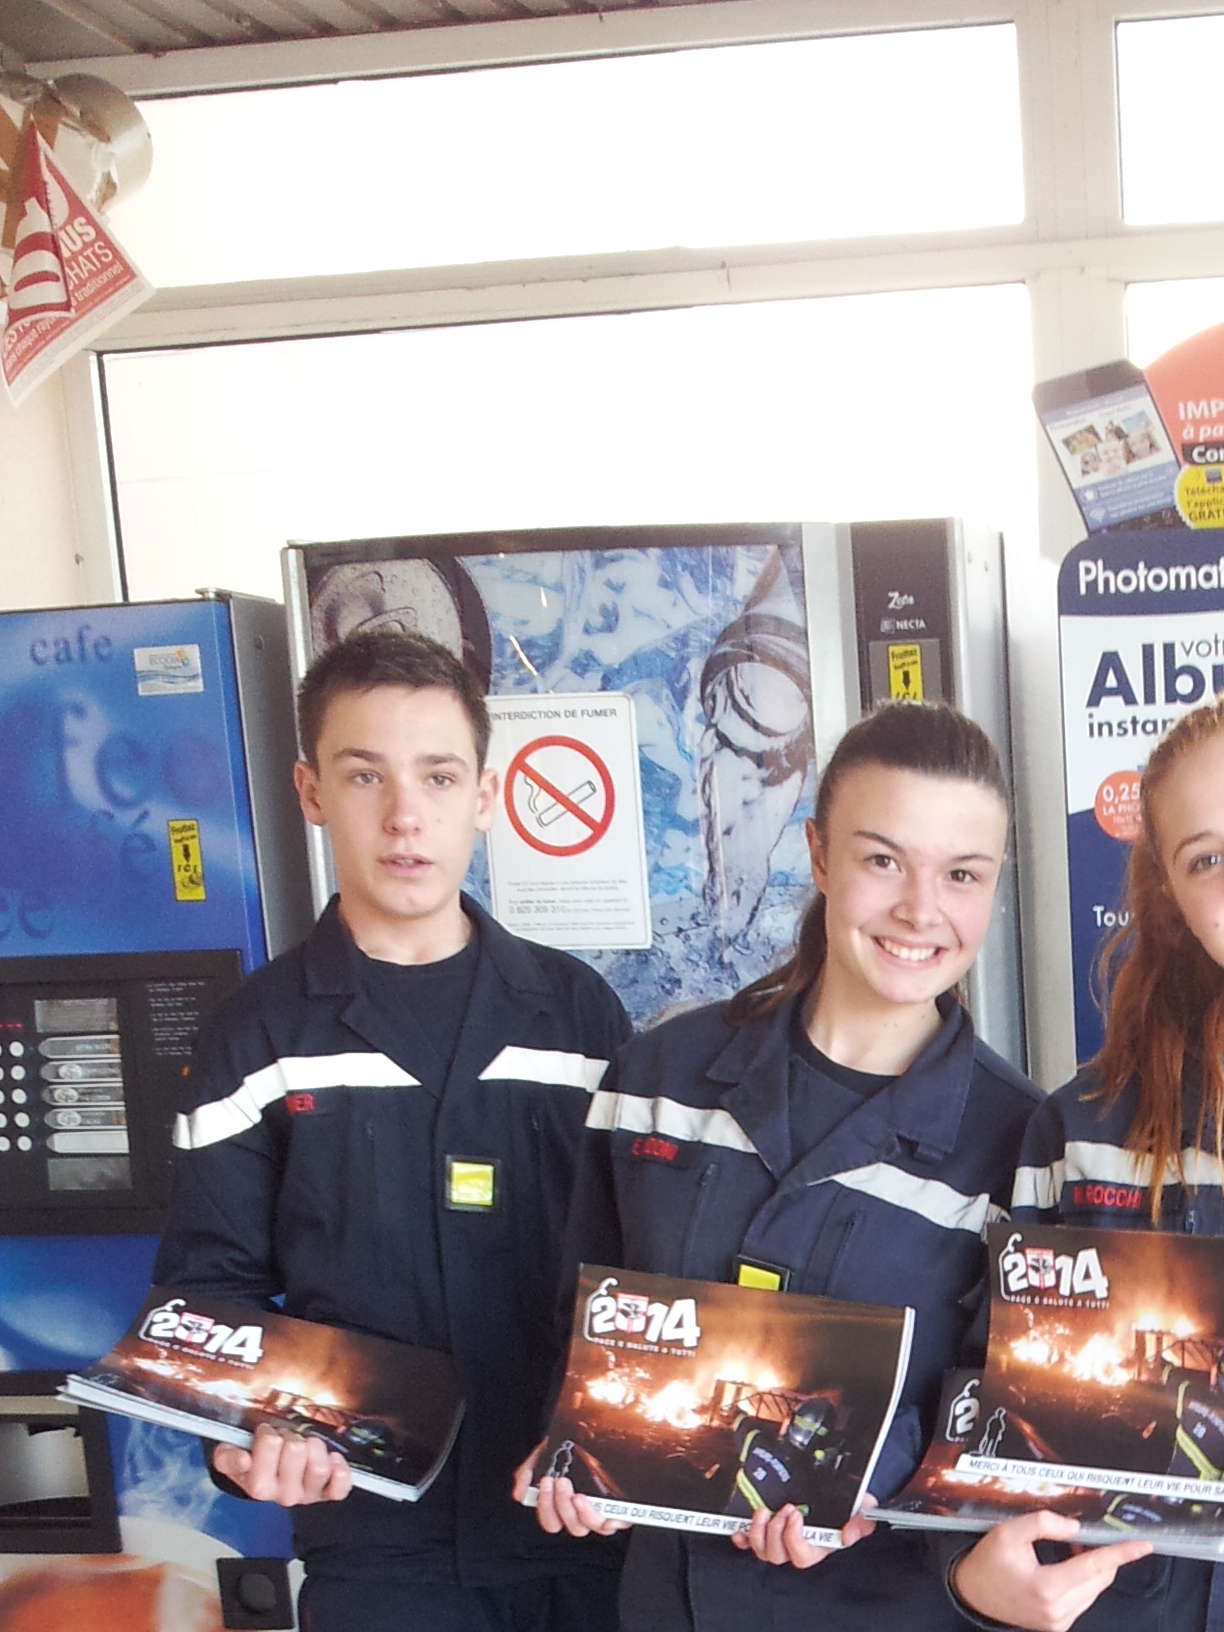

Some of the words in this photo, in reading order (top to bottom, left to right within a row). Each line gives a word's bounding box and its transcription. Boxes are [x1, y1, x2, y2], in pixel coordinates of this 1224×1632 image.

[1182, 422, 1194, 439] à
[896, 618, 926, 631] NECTA
[490, 708, 561, 721] INTERDICTION
[564, 708, 578, 719] DE
[580, 707, 618, 719] FUMER
[1003, 1247, 1109, 1299] 2014
[150, 1311, 264, 1364] 2014
[591, 1293, 702, 1348] 2014
[968, 1459, 1000, 1473] MERCI
[1011, 1464, 1038, 1478] TOUS
[1039, 1466, 1065, 1481] CEUX
[1067, 1470, 1086, 1483] QUI
[1087, 1472, 1136, 1488] RISQUENT
[1138, 1477, 1165, 1491] LEUR
[1166, 1480, 1182, 1493] VIE
[1183, 1482, 1213, 1496] POUR
[604, 1503, 629, 1516] CEUX
[630, 1506, 648, 1518] QUI
[648, 1509, 696, 1525] RISQUENT
[696, 1516, 721, 1529] LEUR
[722, 1518, 738, 1531] VIE
[804, 1529, 818, 1542] LA
[819, 1530, 835, 1543] VIE
